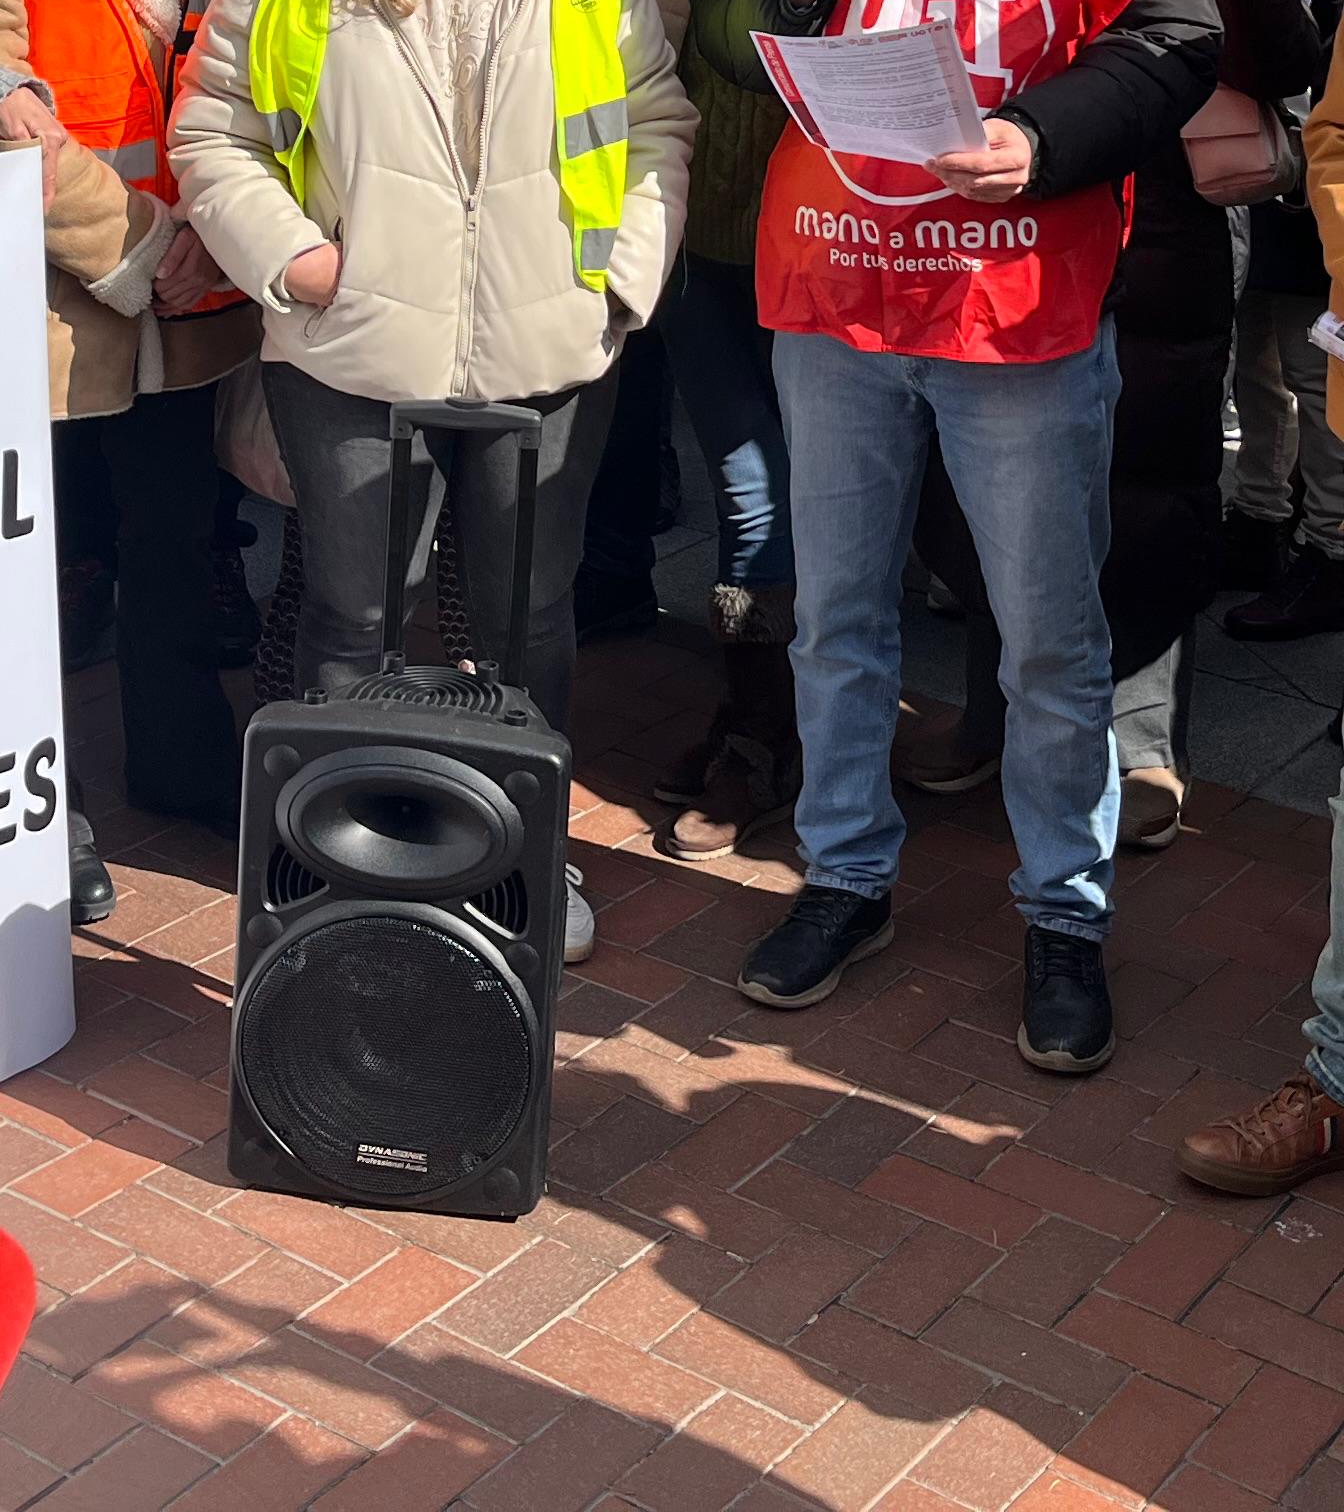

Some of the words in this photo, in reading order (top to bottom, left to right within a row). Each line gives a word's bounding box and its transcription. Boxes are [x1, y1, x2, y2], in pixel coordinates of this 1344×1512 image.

[795, 205, 880, 245] mano
[889, 230, 905, 249] a
[914, 216, 1038, 249] mano
[829, 248, 858, 266] Por
[862, 250, 888, 270] tus
[893, 254, 983, 273] derechos
[357, 1144, 428, 1161] DYNASONIC
[356, 1155, 405, 1169] Professional
[404, 1162, 428, 1173] Audio
